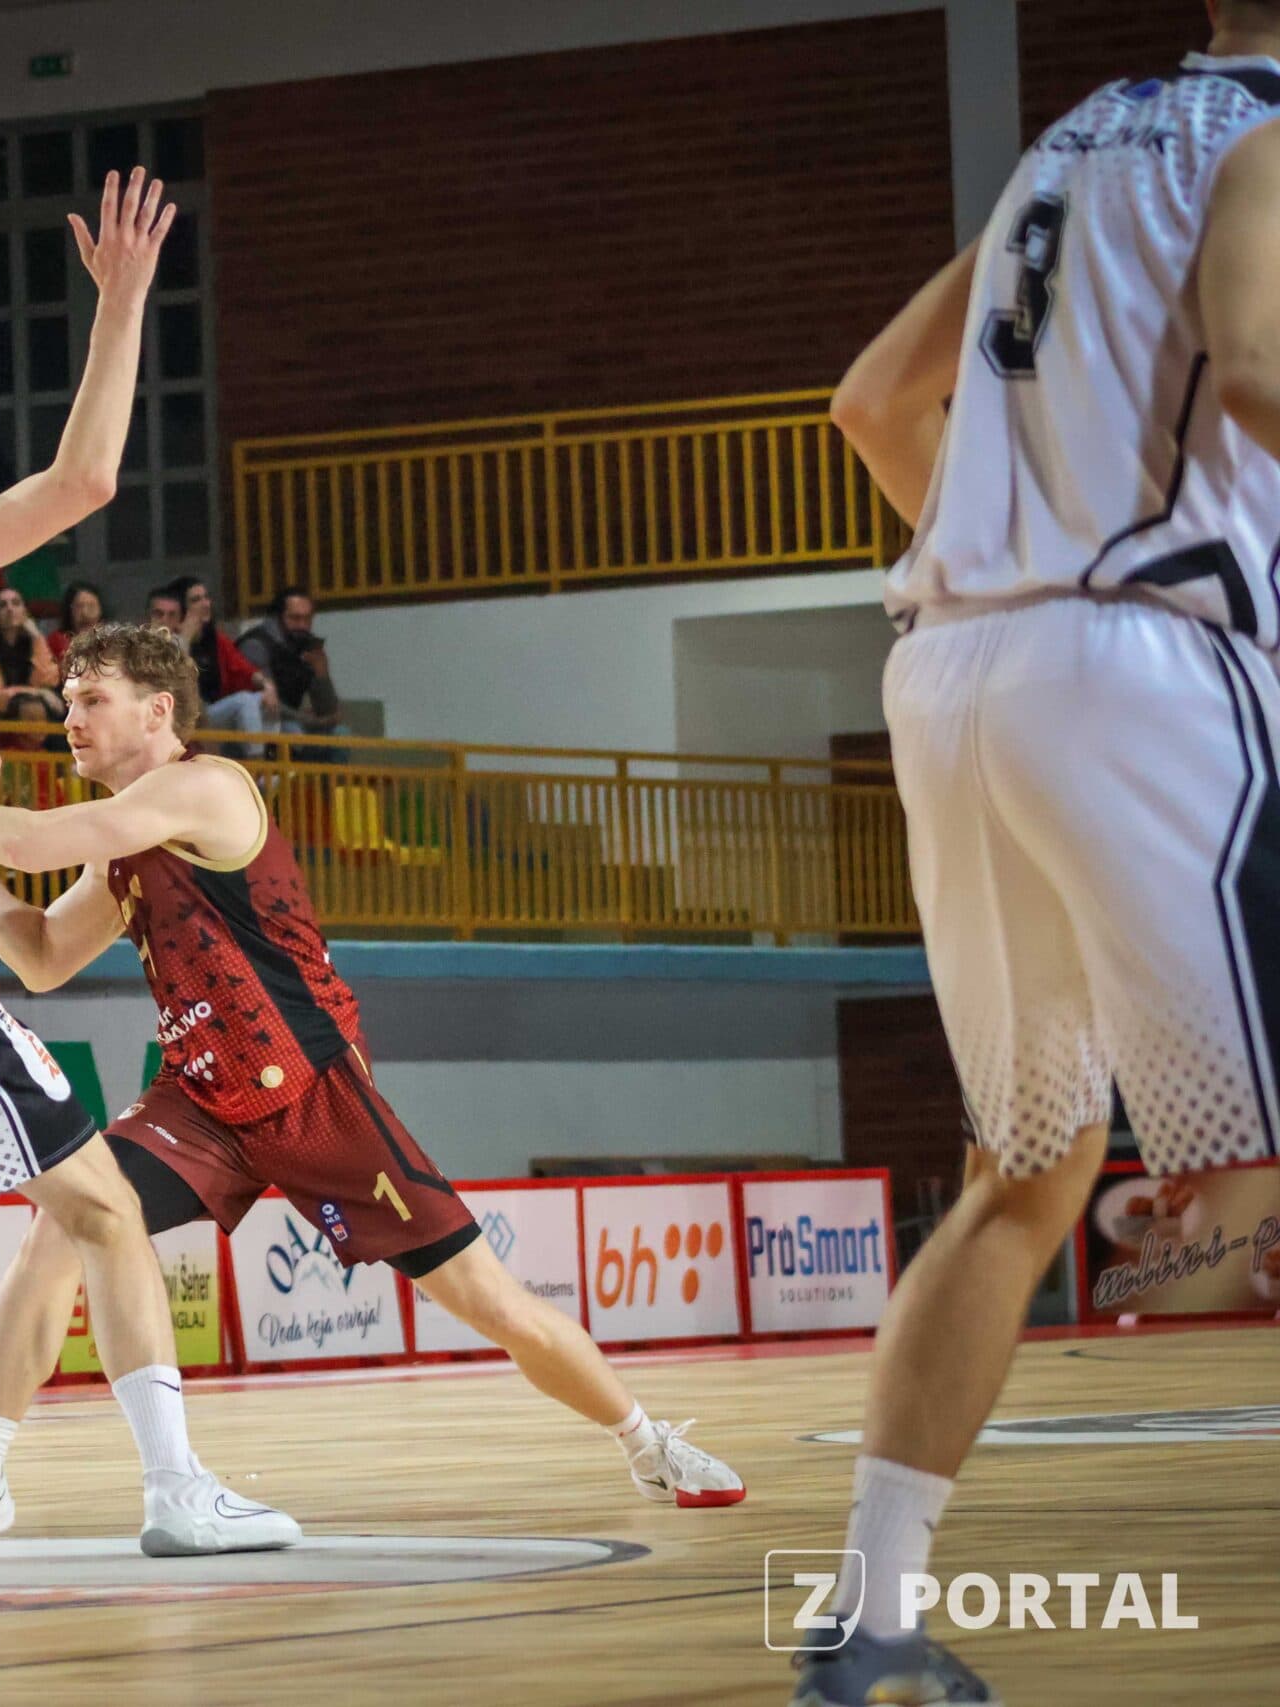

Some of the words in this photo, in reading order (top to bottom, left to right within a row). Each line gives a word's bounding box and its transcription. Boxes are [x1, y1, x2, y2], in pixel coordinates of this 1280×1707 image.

[978, 191, 1069, 379] 3
[372, 1170, 412, 1222] 1
[595, 1226, 659, 1309] bh
[746, 1215, 882, 1278] ProSmart
[779, 1285, 855, 1304] SOLUTIONS
